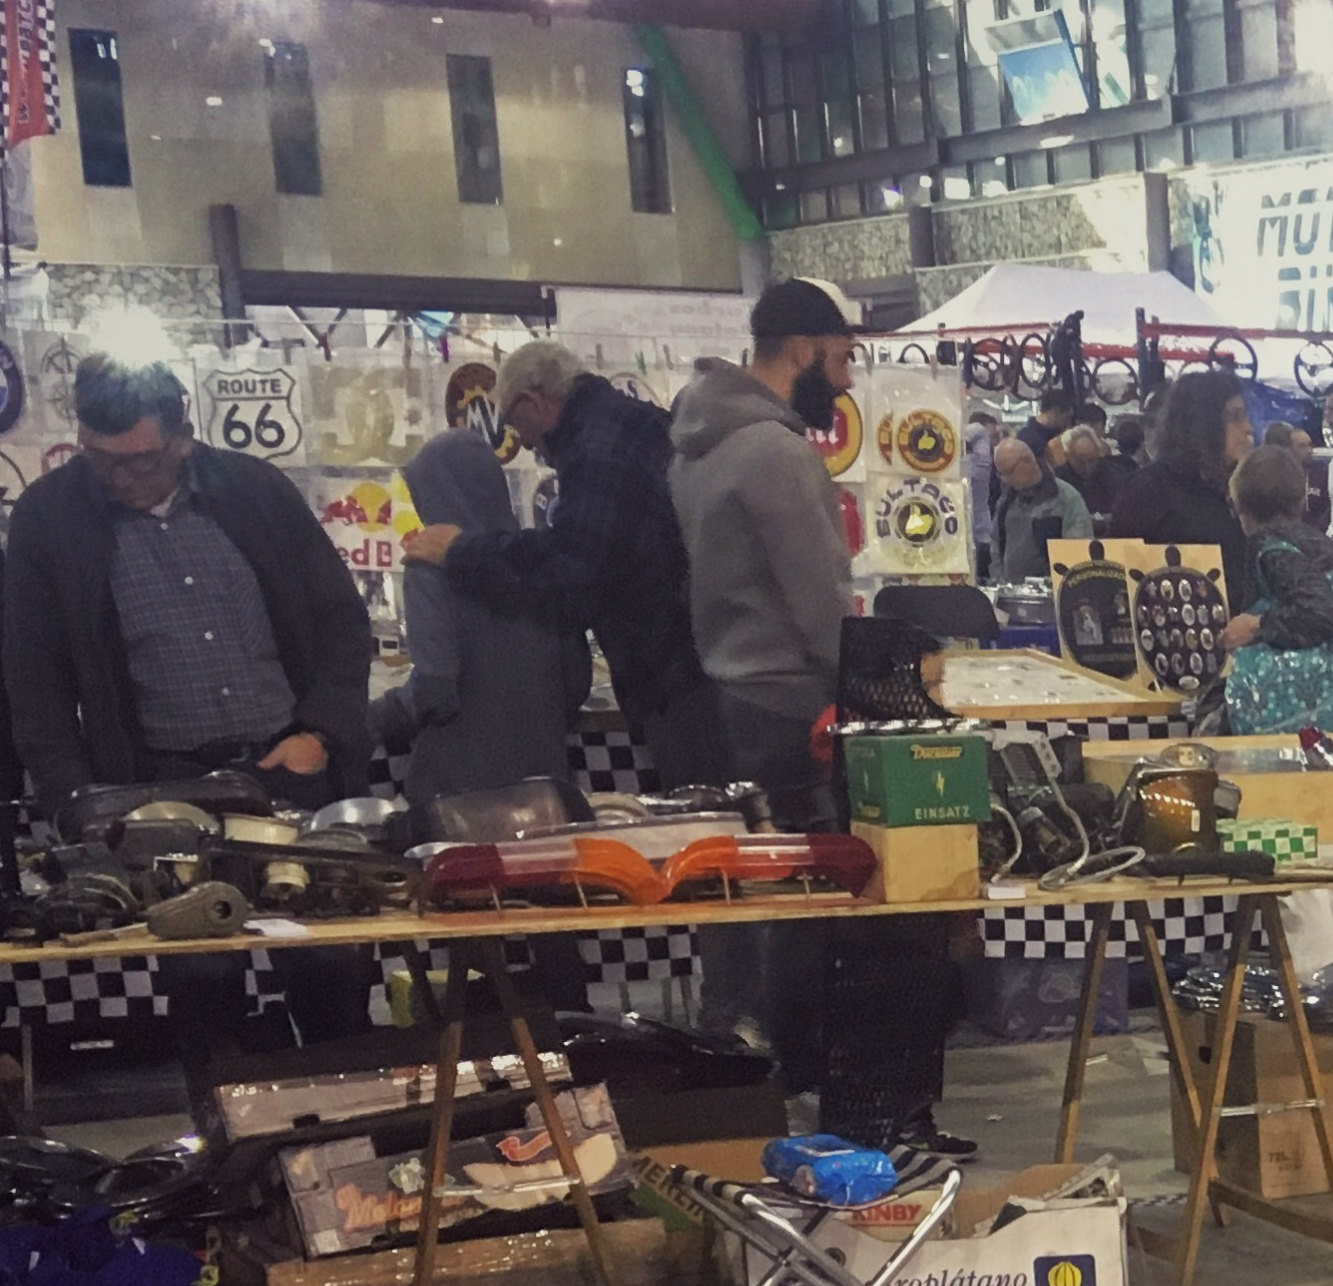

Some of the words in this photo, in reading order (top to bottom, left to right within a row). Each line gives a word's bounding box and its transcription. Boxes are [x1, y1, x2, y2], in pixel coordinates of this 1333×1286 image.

[217, 378, 282, 394] ROUTE
[223, 402, 285, 449] 66
[914, 804, 970, 820] EINSATZ
